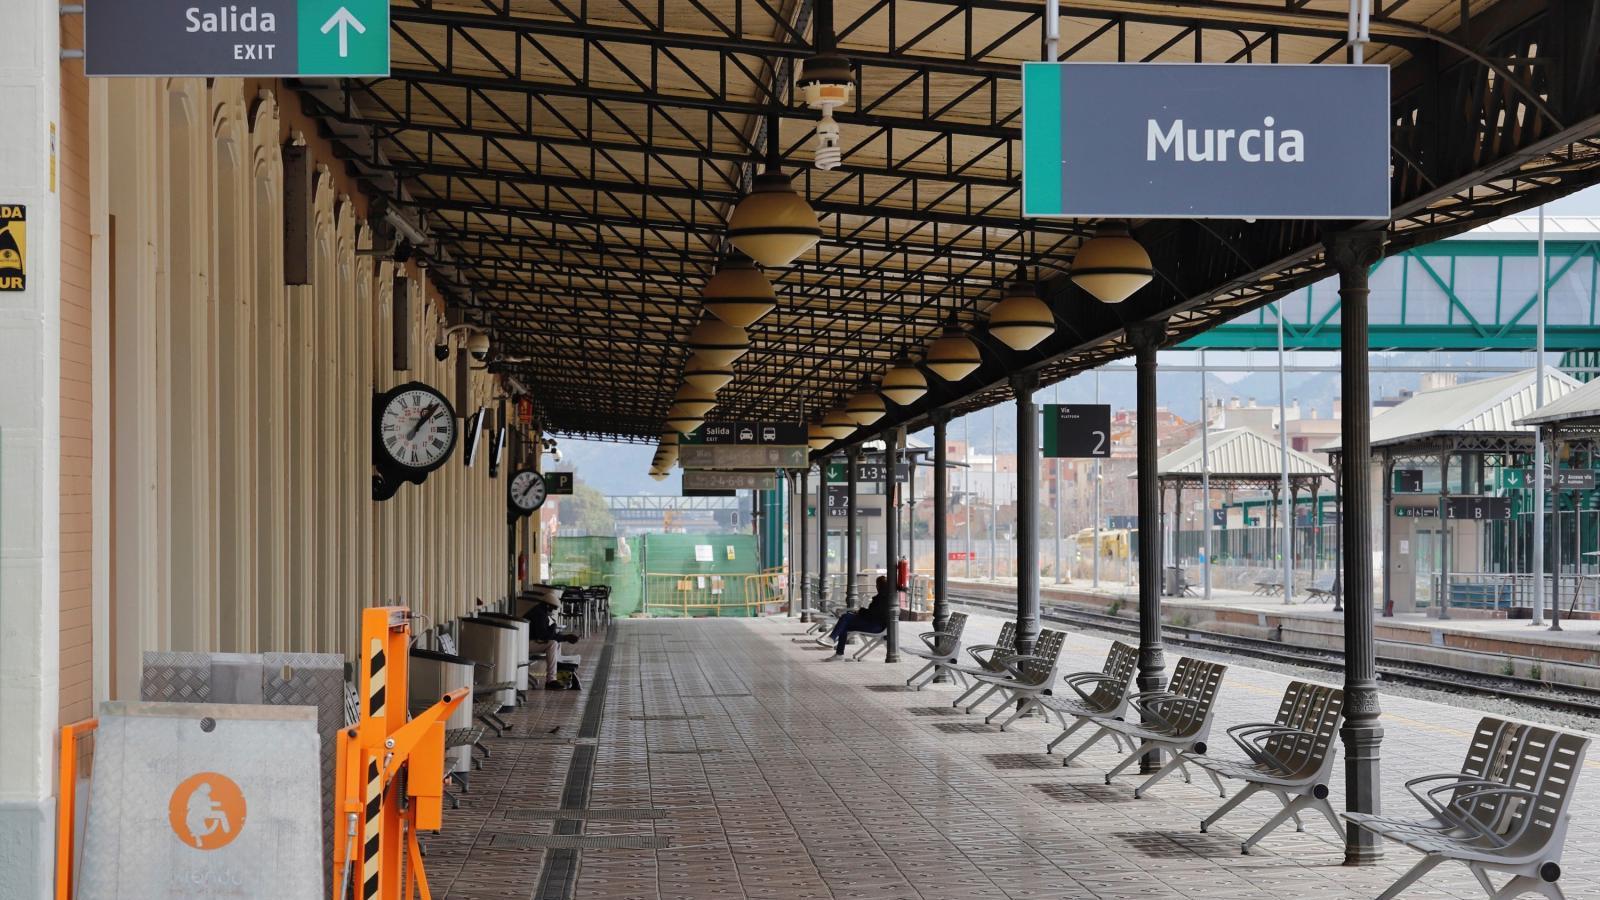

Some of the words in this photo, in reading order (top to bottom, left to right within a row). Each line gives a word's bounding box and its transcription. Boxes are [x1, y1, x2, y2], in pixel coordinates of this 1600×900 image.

[185, 6, 276, 33] Salida
[233, 44, 276, 61] EXIT
[1146, 115, 1305, 163] Murcia
[0, 206, 23, 218] DA
[706, 426, 730, 435] Salida
[1092, 430, 1105, 455] 2
[560, 475, 568, 488] P
[1414, 480, 1421, 492] 1
[828, 495, 835, 507] B
[842, 495, 849, 507] 2
[1448, 507, 1455, 518] 1
[1475, 507, 1482, 519] B
[1504, 507, 1511, 519] 3
